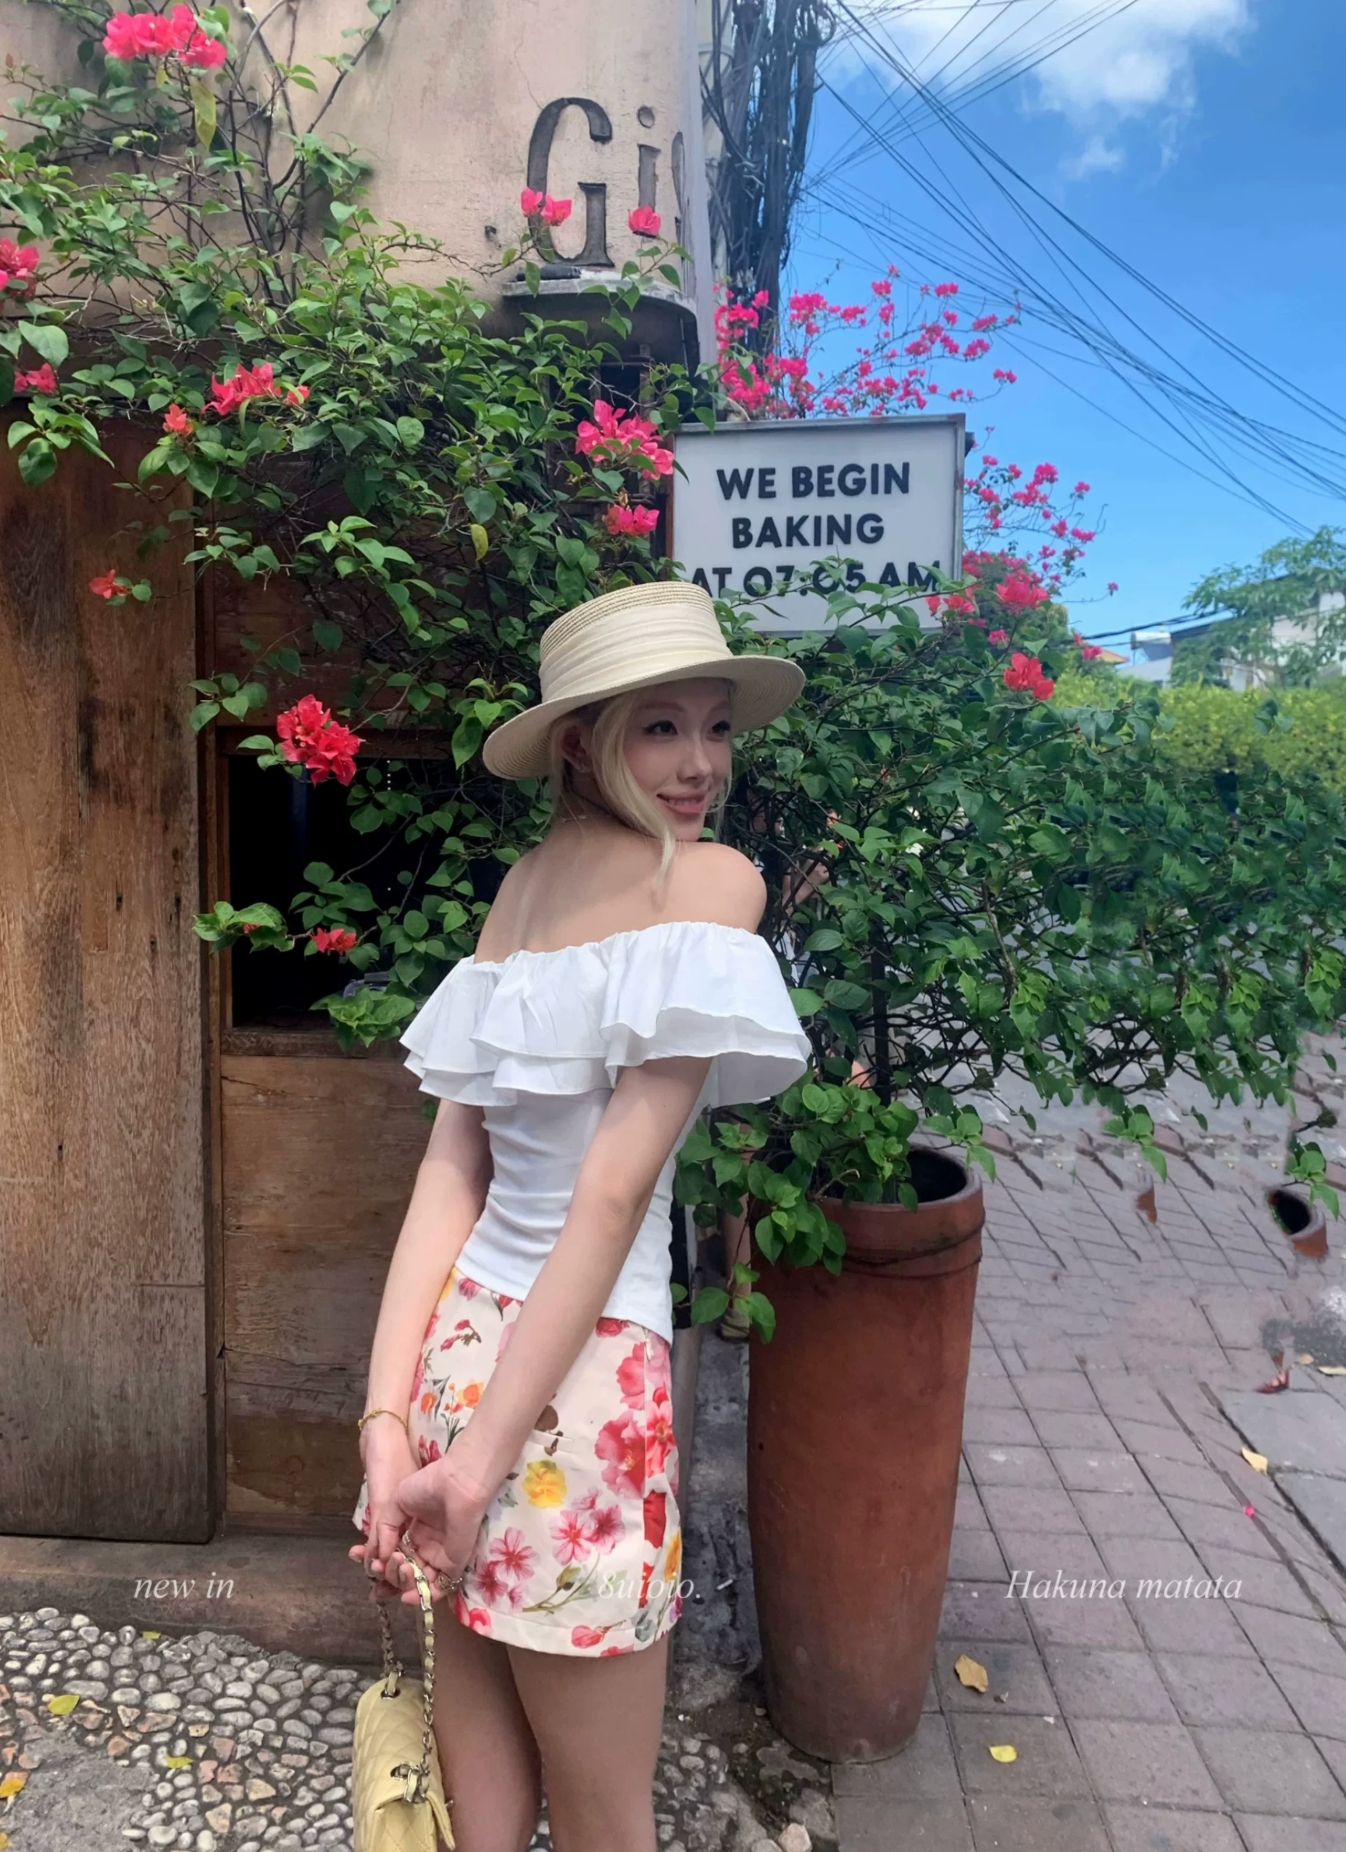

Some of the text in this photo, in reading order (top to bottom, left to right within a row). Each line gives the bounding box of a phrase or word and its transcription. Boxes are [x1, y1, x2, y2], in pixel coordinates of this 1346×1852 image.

[717, 462, 910, 500] WE BEGIN
[732, 513, 884, 549] BAKING
[691, 560, 941, 599] AT 07:05 AM
